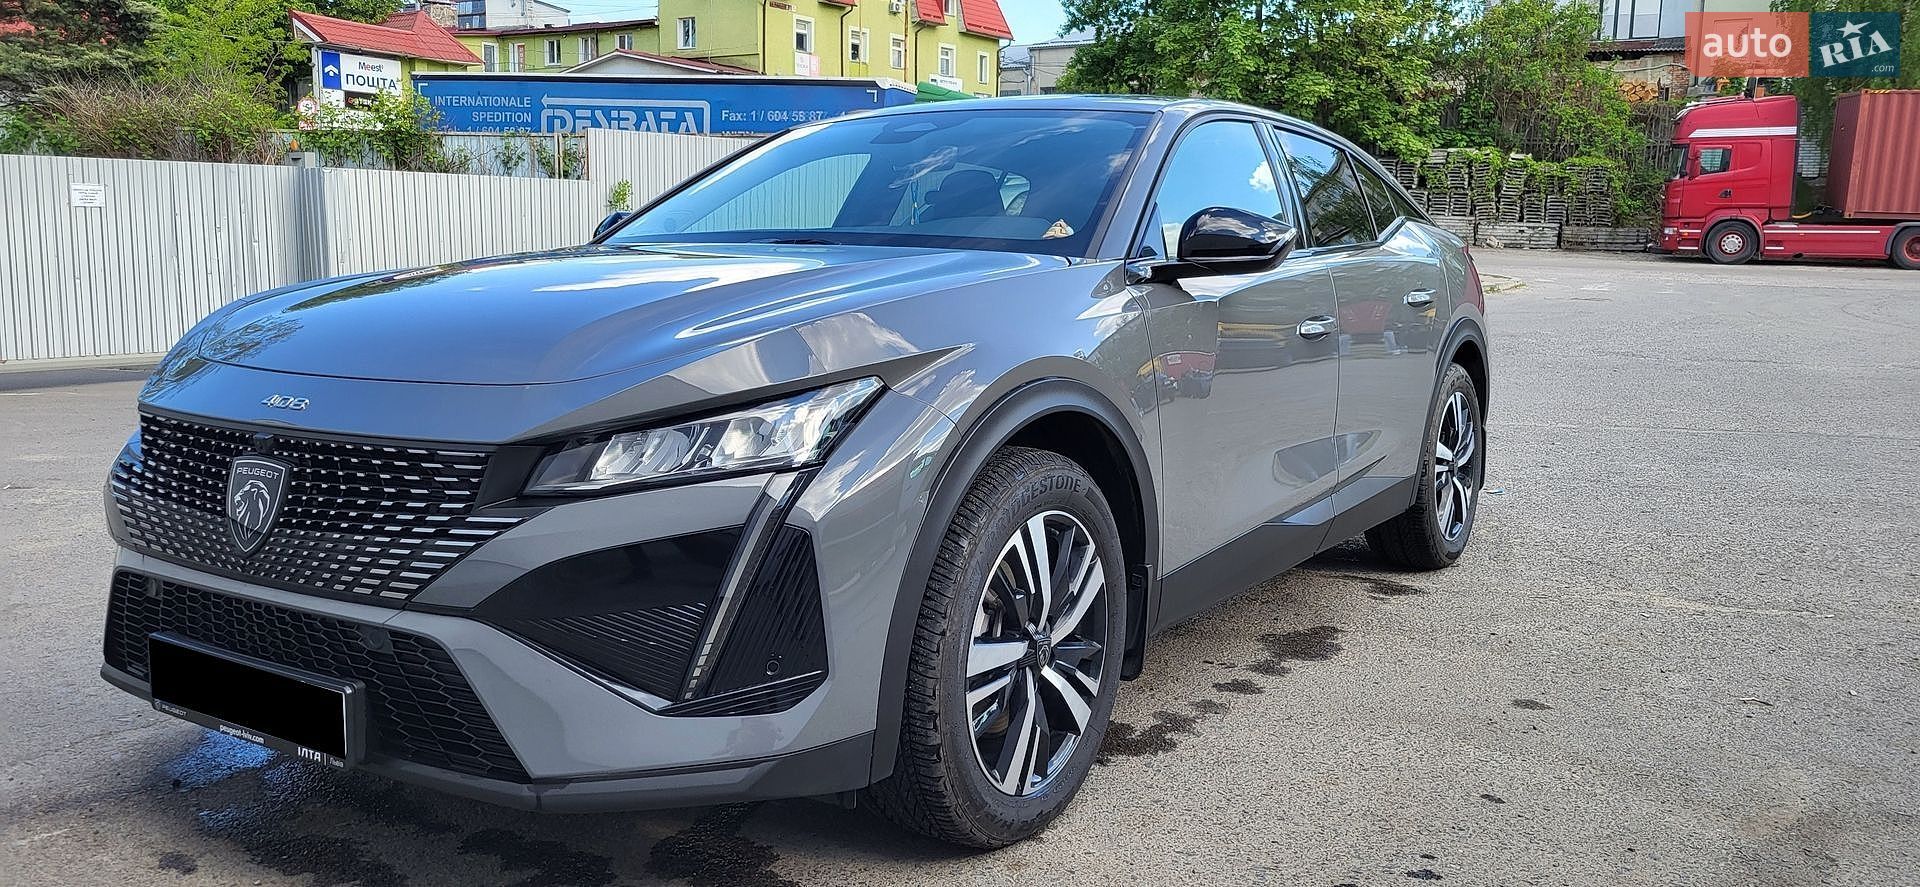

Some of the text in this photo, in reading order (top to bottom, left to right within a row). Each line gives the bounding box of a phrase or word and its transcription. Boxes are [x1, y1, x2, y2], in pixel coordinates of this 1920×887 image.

[358, 61, 383, 73] Meest
[345, 73, 398, 91] ПОШТА
[434, 95, 532, 108] INTERNATIONALE
[472, 111, 532, 123] SPEDITION
[721, 109, 747, 121] Fax:
[767, 111, 788, 121] 604
[260, 394, 310, 411] 408
[236, 467, 280, 480] PEUGEOT
